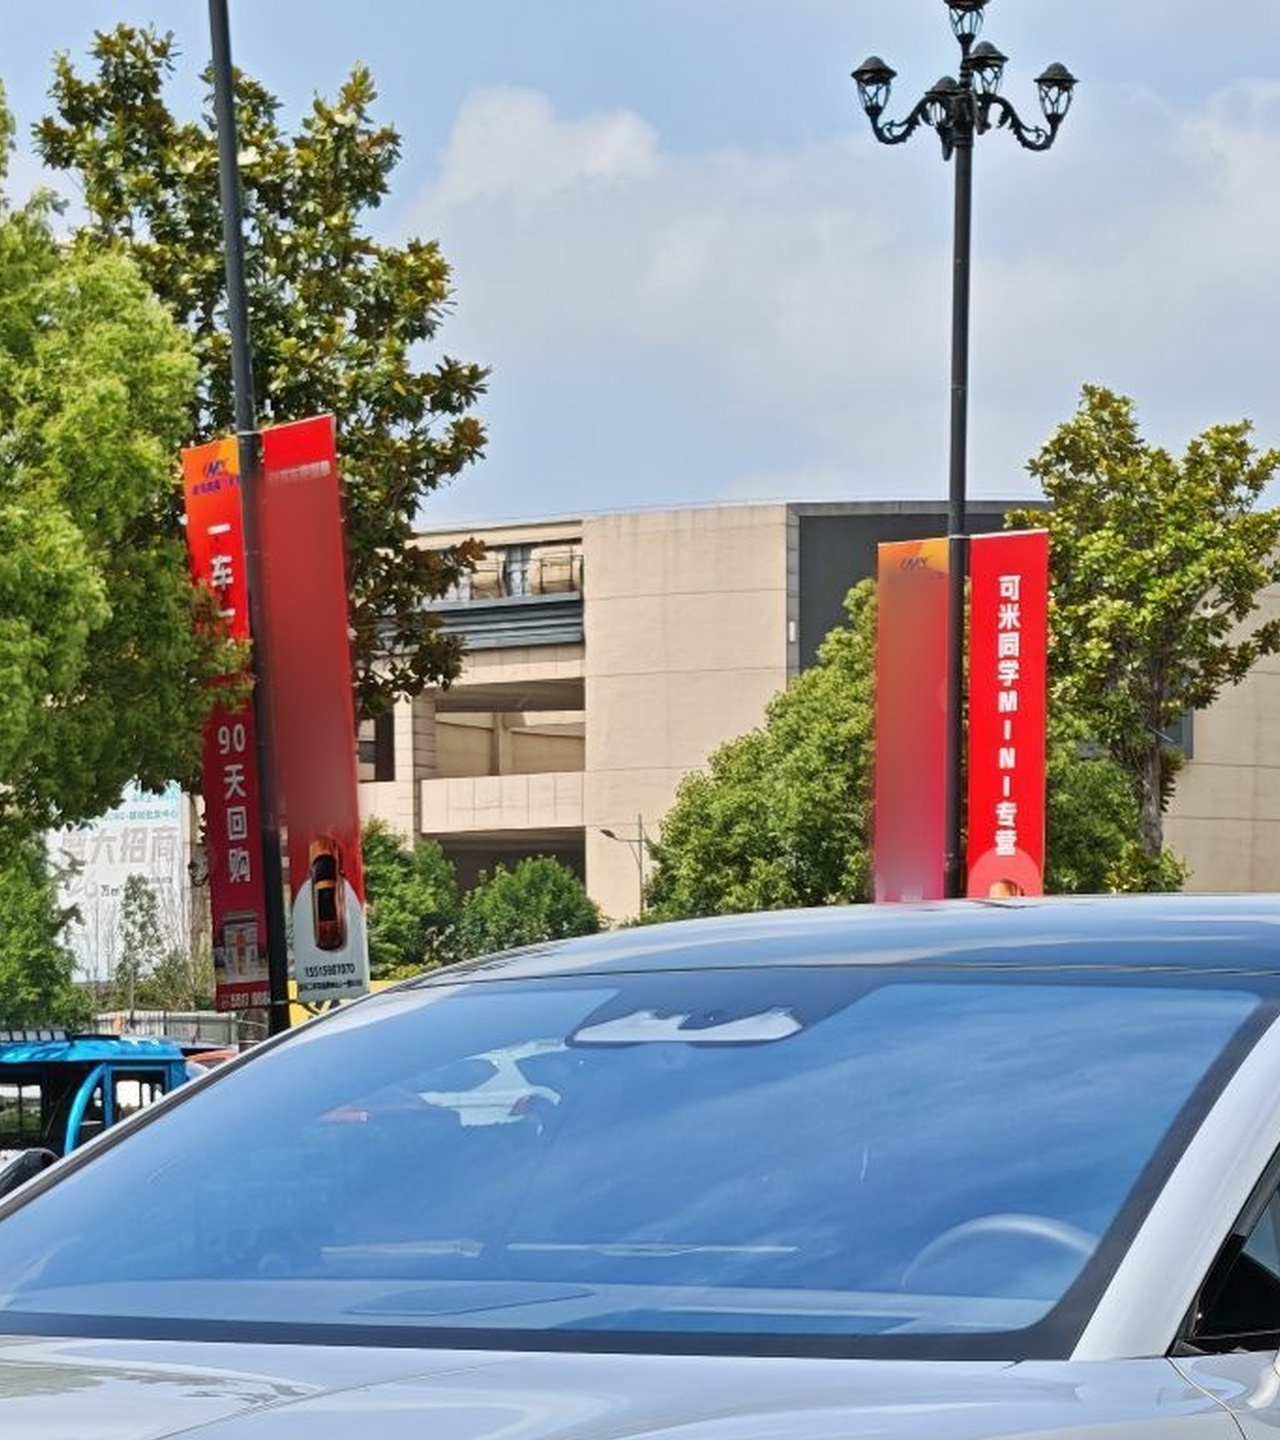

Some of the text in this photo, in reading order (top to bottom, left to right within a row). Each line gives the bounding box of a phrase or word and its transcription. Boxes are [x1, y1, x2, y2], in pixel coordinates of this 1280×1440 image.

[218, 723, 251, 884] 90天回购
[994, 574, 1021, 857] 可米同学MINI专营
